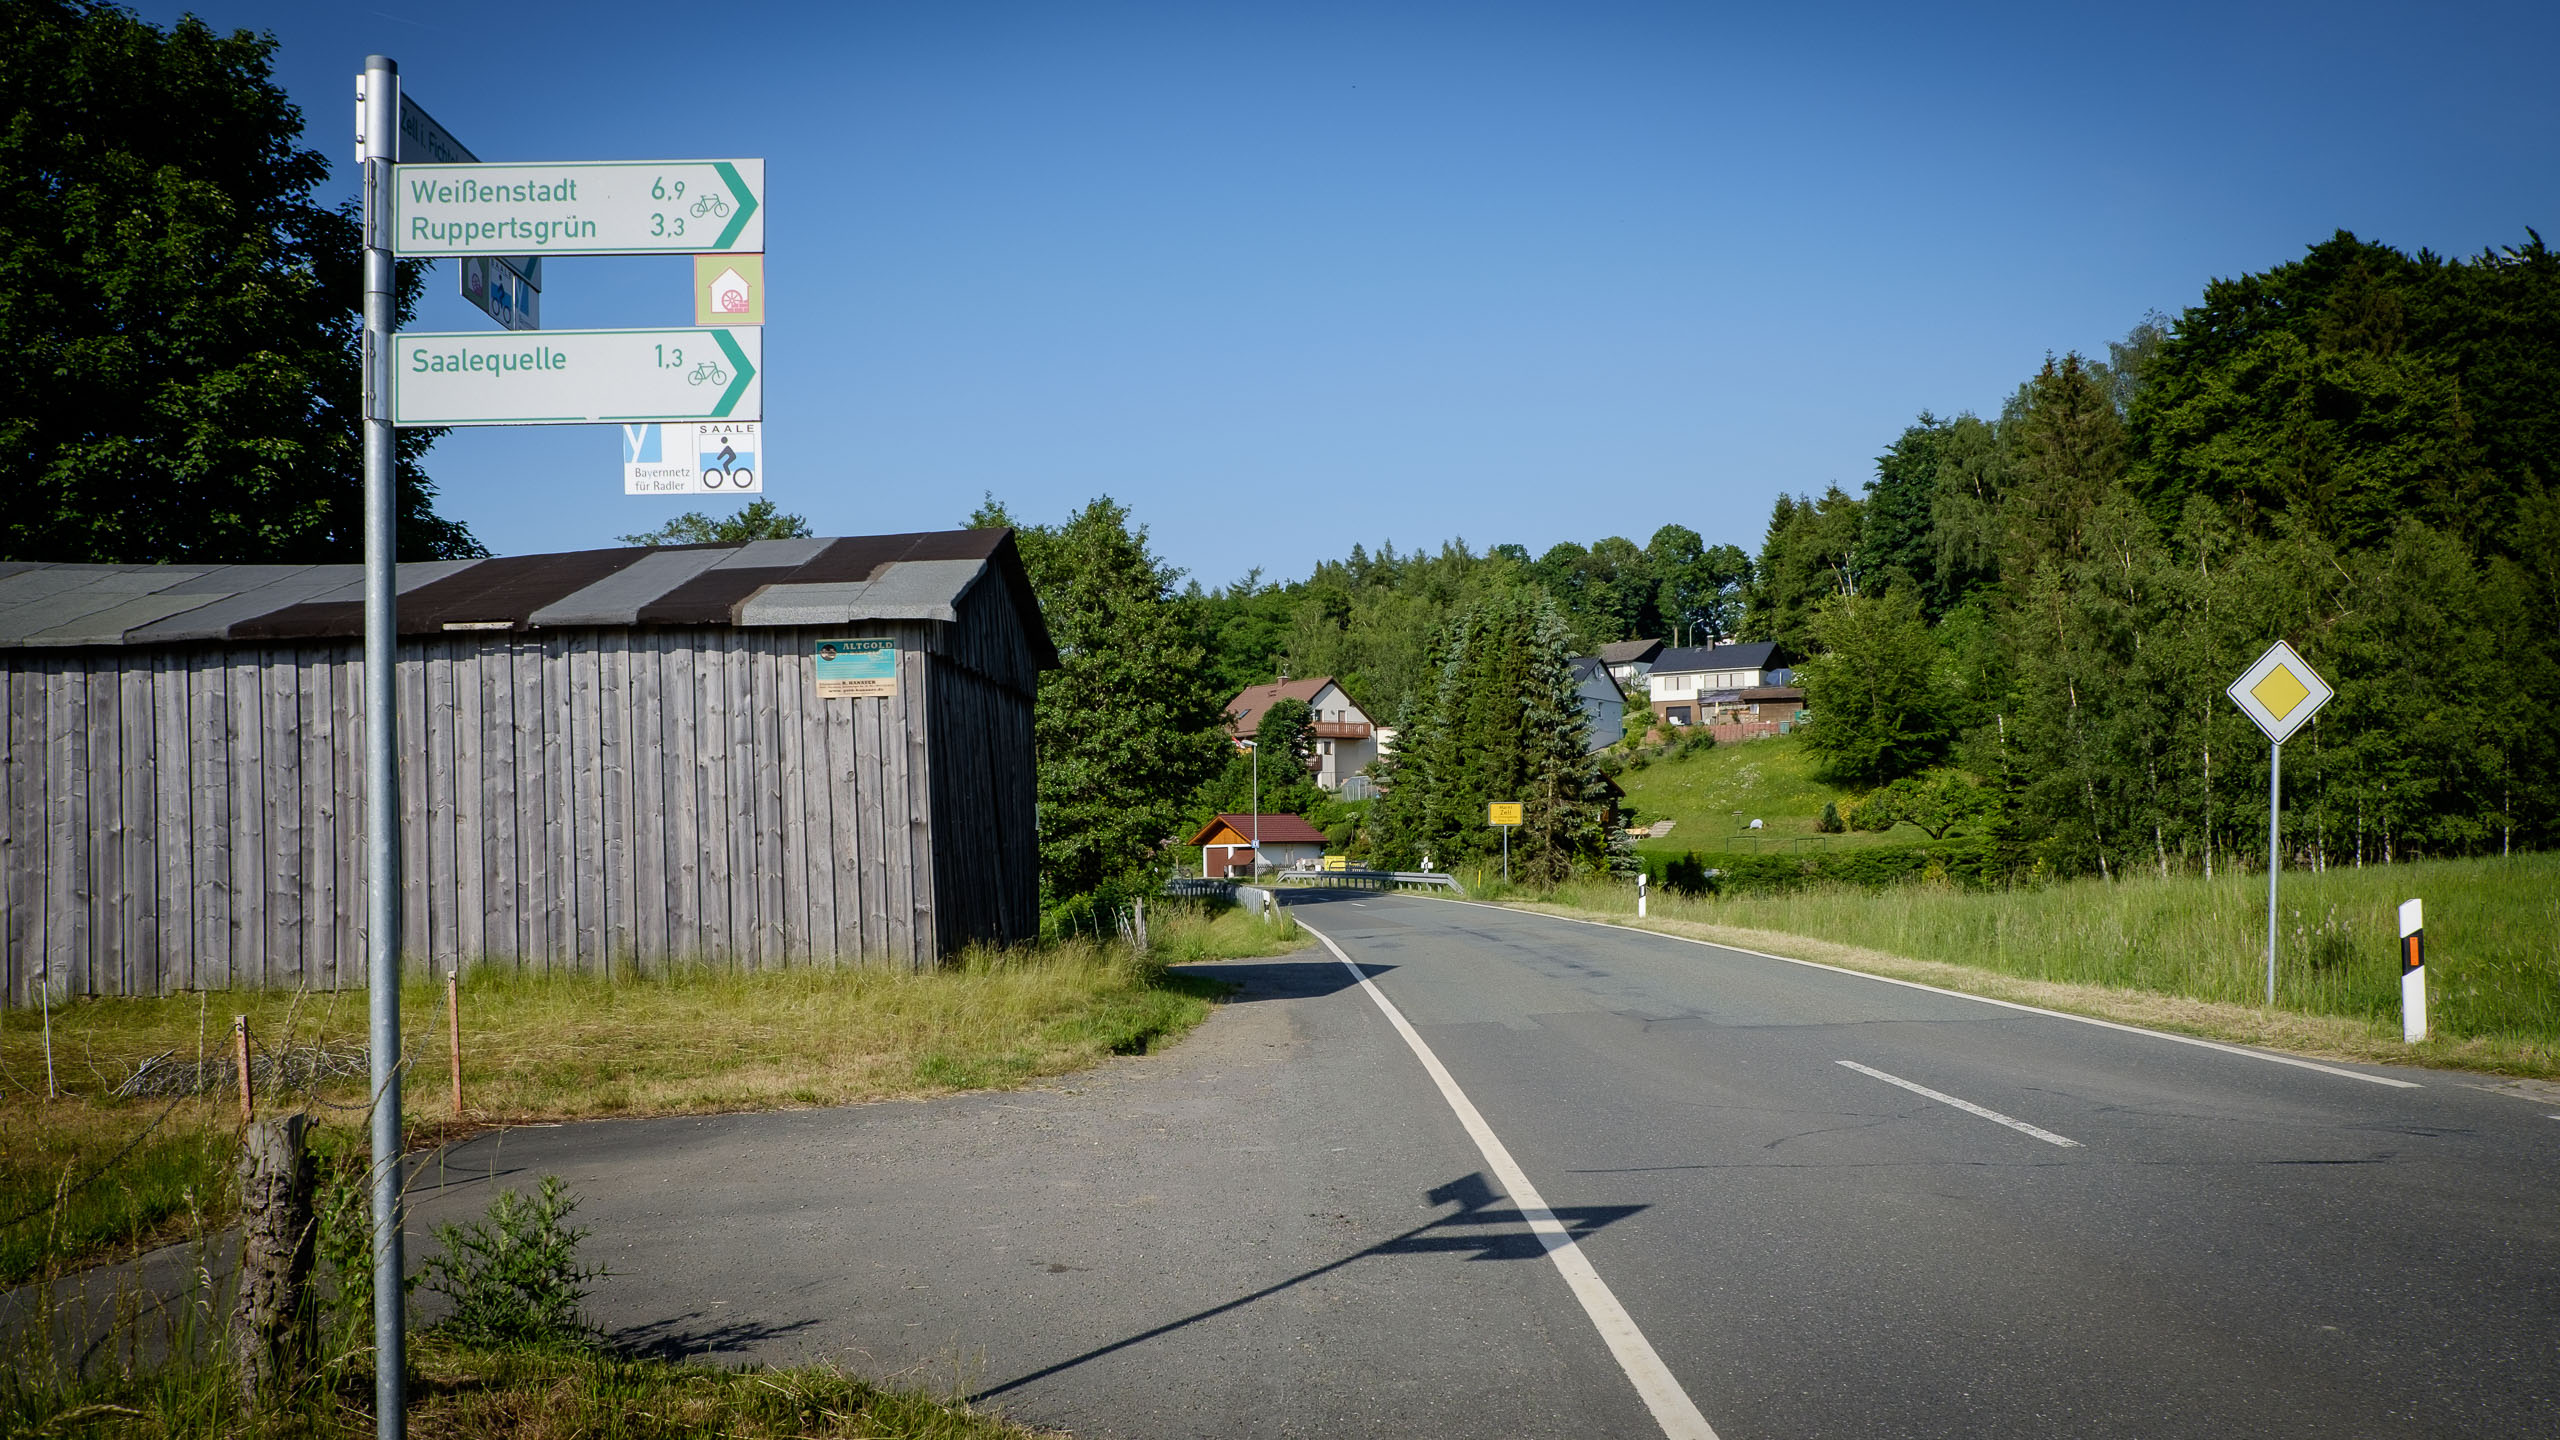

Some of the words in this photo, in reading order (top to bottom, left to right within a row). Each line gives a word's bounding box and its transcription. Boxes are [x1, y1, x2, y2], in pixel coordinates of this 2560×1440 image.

[400, 107, 418, 143] Zell
[411, 178, 577, 204] Weißenstadt
[651, 176, 686, 202] 6,9
[411, 215, 597, 246] Ruppertsgrün
[650, 212, 685, 239] 3,3
[412, 346, 567, 378] Saalequelle
[654, 344, 684, 370] 1,3
[699, 424, 755, 434] SAALE
[635, 467, 691, 480] Bayernnetz
[635, 481, 650, 491] für
[653, 480, 685, 491] Radler
[843, 641, 893, 650] ALTGOLD
